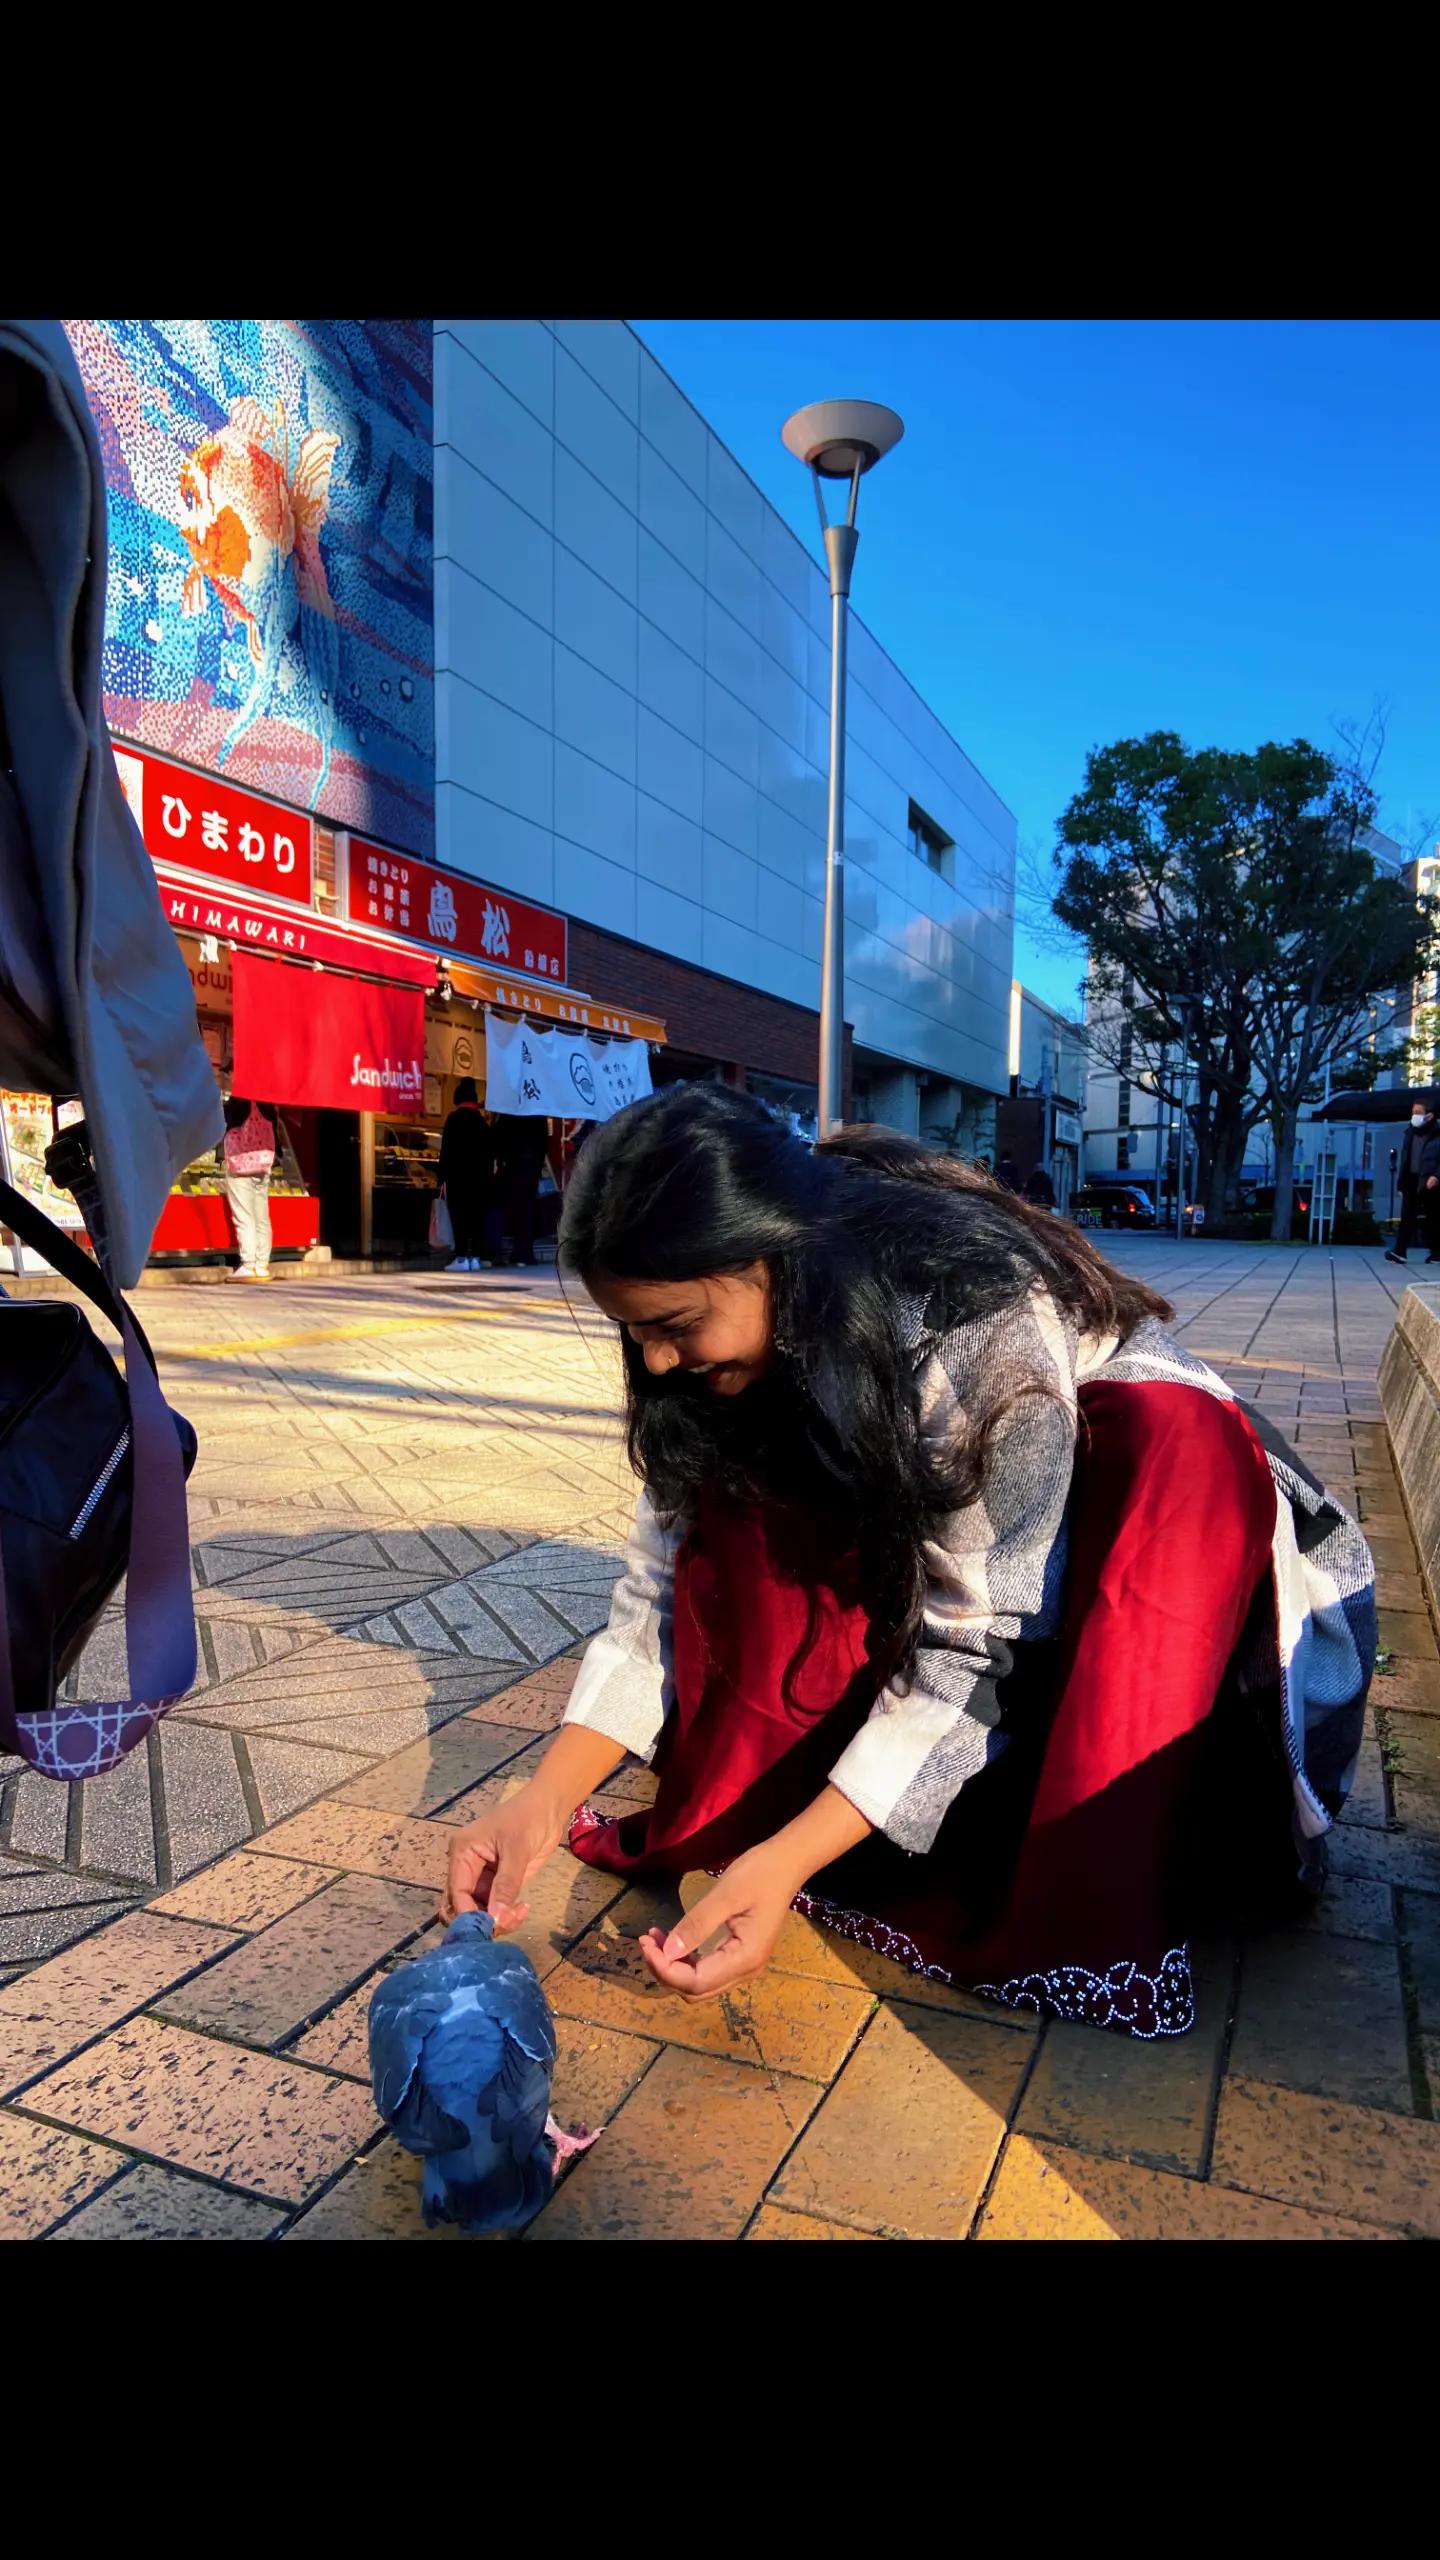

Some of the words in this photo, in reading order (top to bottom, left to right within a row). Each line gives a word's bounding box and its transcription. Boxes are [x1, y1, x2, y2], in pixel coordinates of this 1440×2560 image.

[161, 794, 296, 874] ひまわり
[170, 899, 306, 950] HIMAWARI
[350, 1053, 422, 1089] Sandwich
